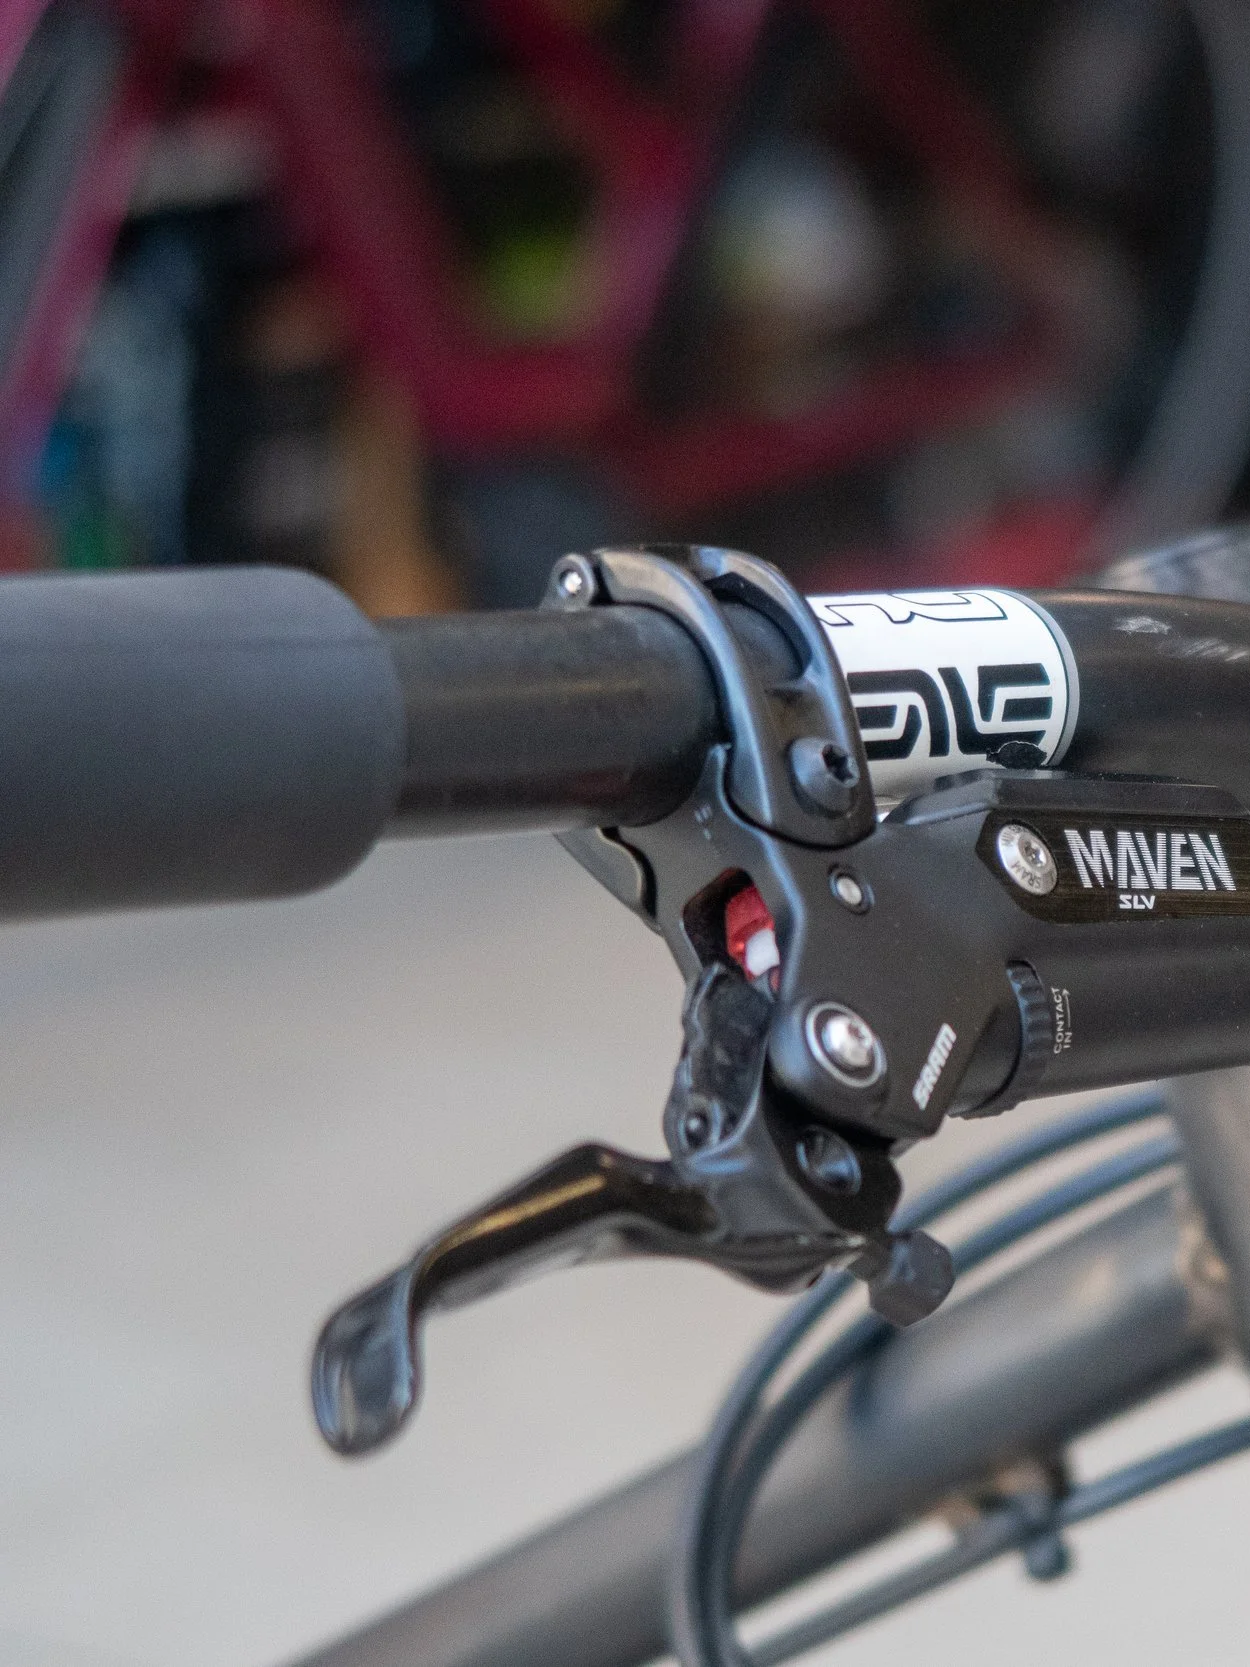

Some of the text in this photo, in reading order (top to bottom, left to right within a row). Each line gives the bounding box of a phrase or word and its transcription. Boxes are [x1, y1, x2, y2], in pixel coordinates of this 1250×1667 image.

[1063, 828, 1237, 892] MAVEN
[1118, 894, 1156, 910] SLV
[1051, 986, 1065, 1054] CONTACT
[1063, 1031, 1073, 1049] IN
[912, 1022, 957, 1111] SRAM
